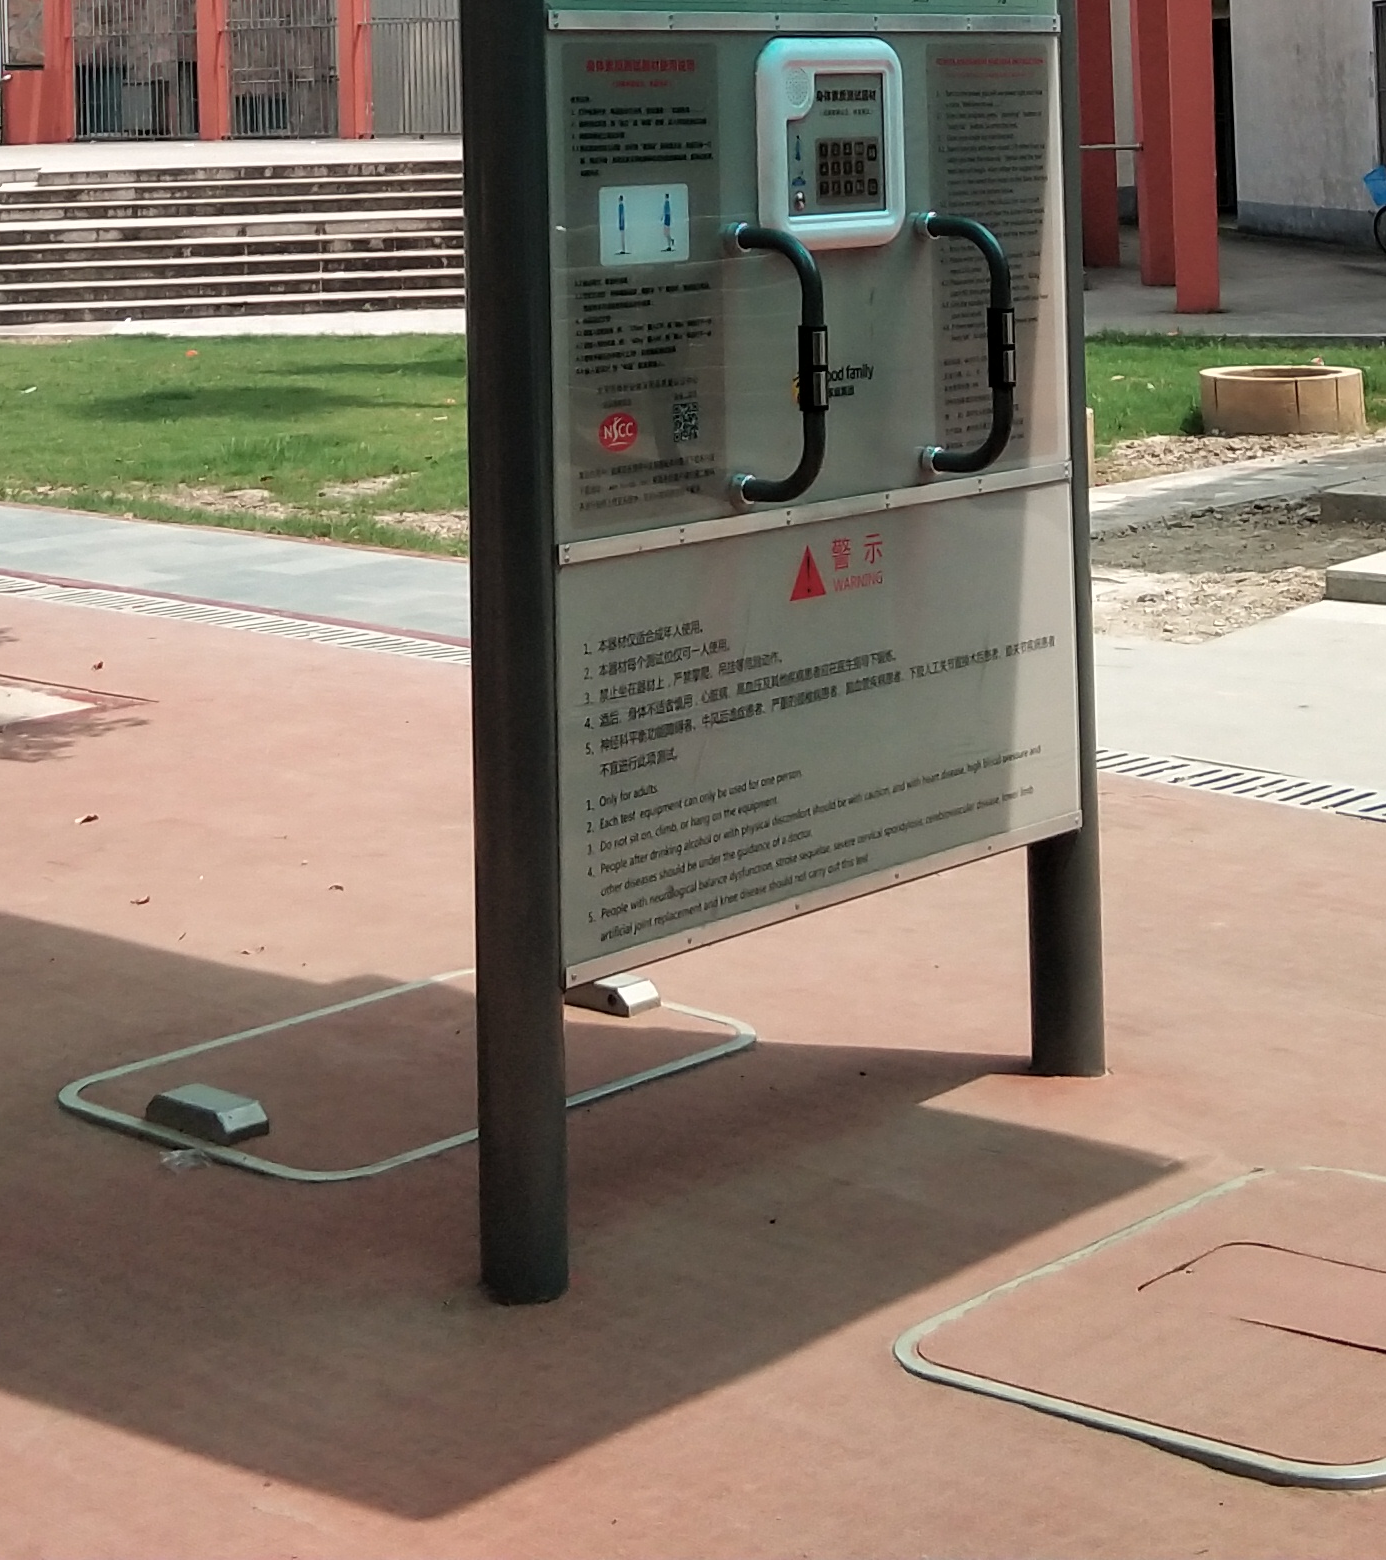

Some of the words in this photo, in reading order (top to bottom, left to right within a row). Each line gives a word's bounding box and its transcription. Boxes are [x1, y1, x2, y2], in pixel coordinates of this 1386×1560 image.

[846, 363, 874, 380] family
[831, 531, 883, 571] 警示
[833, 569, 883, 593] WARNING
[599, 792, 616, 809] Only
[620, 788, 631, 802] for
[599, 813, 618, 830] Each
[683, 794, 697, 807] can
[699, 789, 715, 806] only
[717, 786, 726, 799] be
[600, 838, 610, 852] Do
[614, 835, 627, 848] not
[723, 806, 736, 818] the
[600, 856, 627, 877] People
